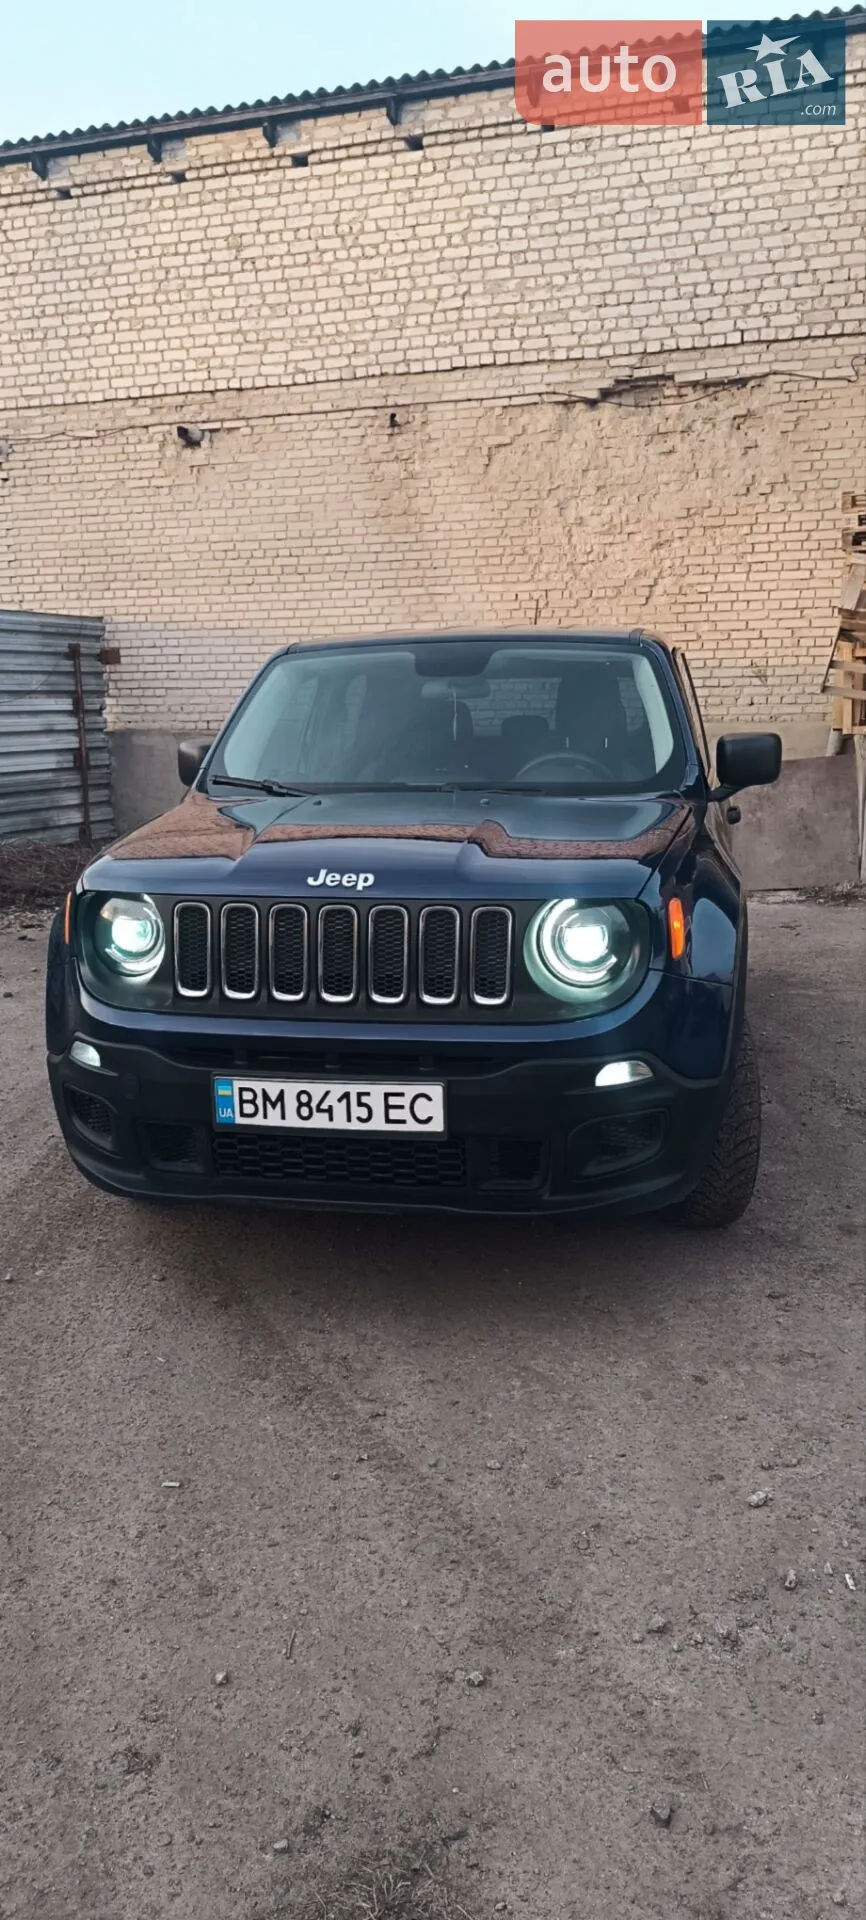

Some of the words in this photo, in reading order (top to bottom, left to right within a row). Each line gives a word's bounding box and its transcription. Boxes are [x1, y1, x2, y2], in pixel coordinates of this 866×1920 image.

[306, 868, 375, 891] Jeep
[218, 1107, 234, 1118] UA
[238, 1086, 286, 1120] BM
[296, 1089, 373, 1123] 8415
[383, 1091, 434, 1125] EC
